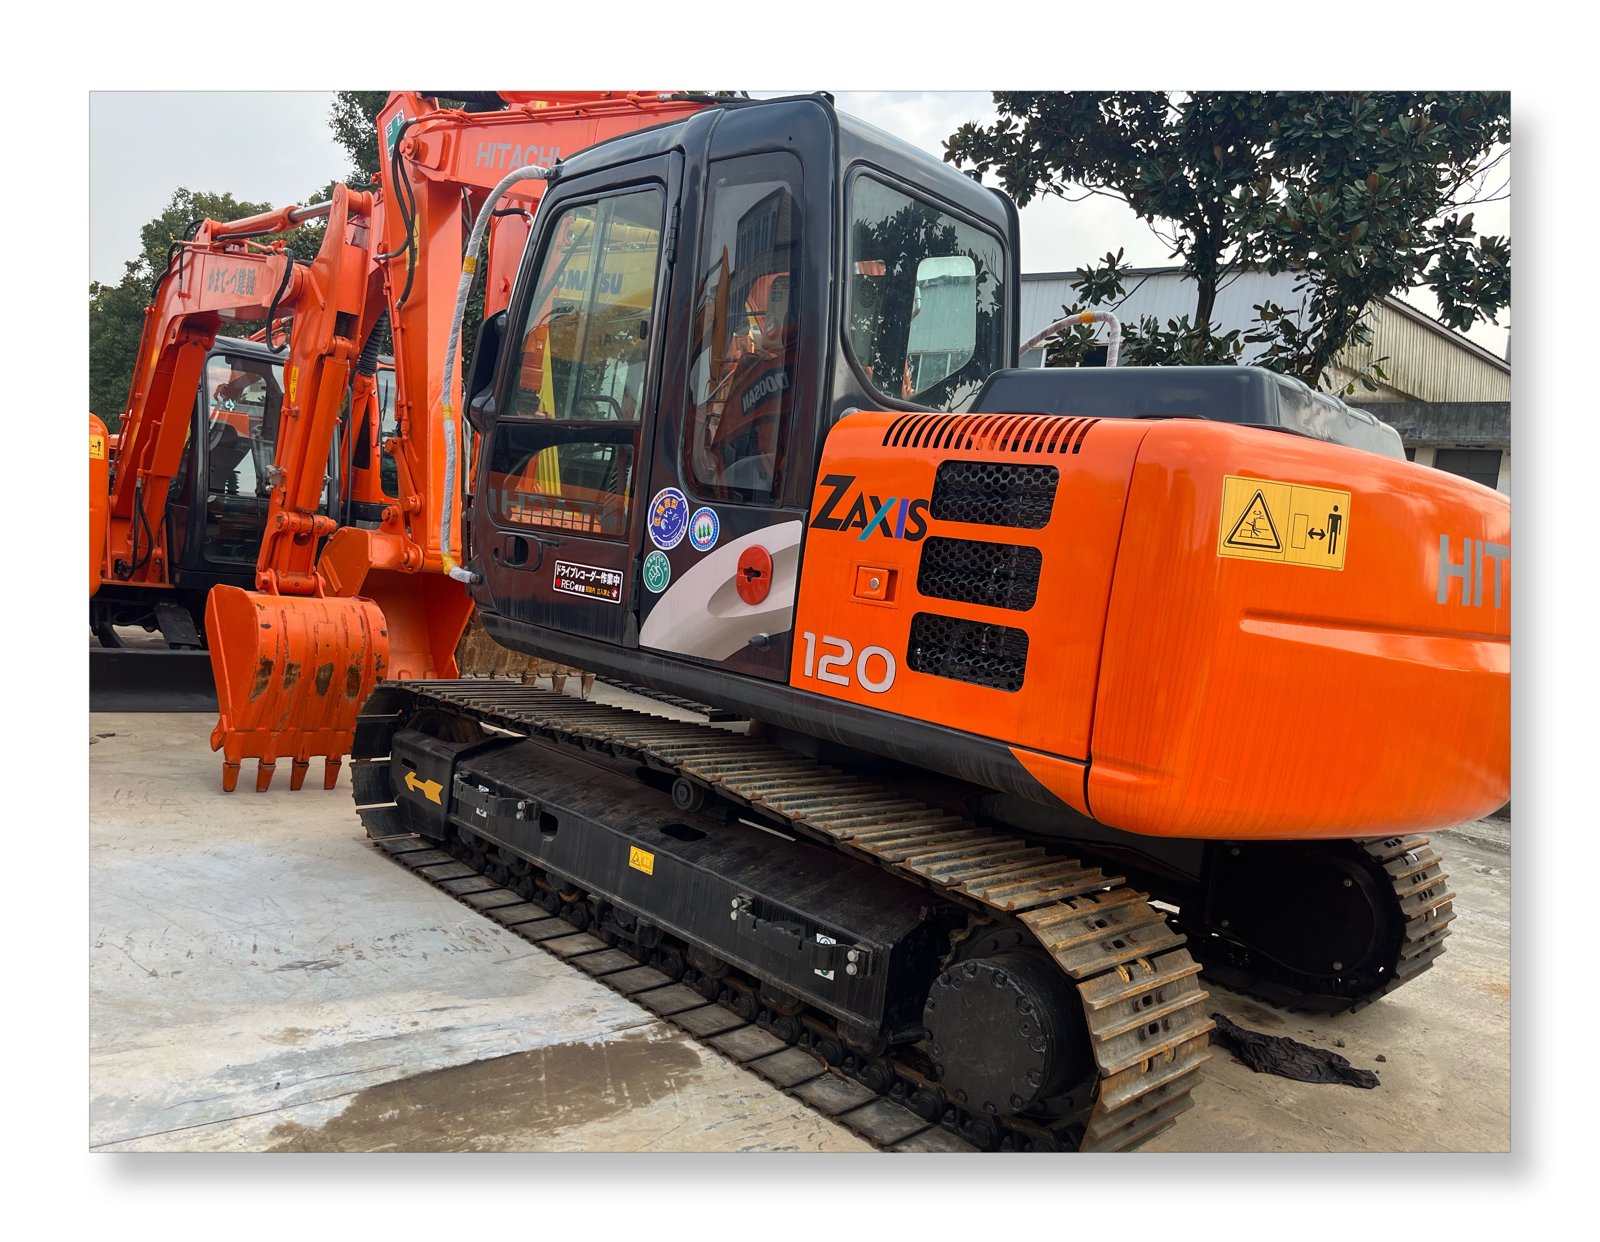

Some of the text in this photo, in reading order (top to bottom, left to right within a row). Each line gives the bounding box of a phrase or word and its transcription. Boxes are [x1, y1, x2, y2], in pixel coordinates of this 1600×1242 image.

[810, 474, 929, 541] ZAXIS
[1436, 534, 1510, 609] HIT
[803, 631, 897, 693] 120
